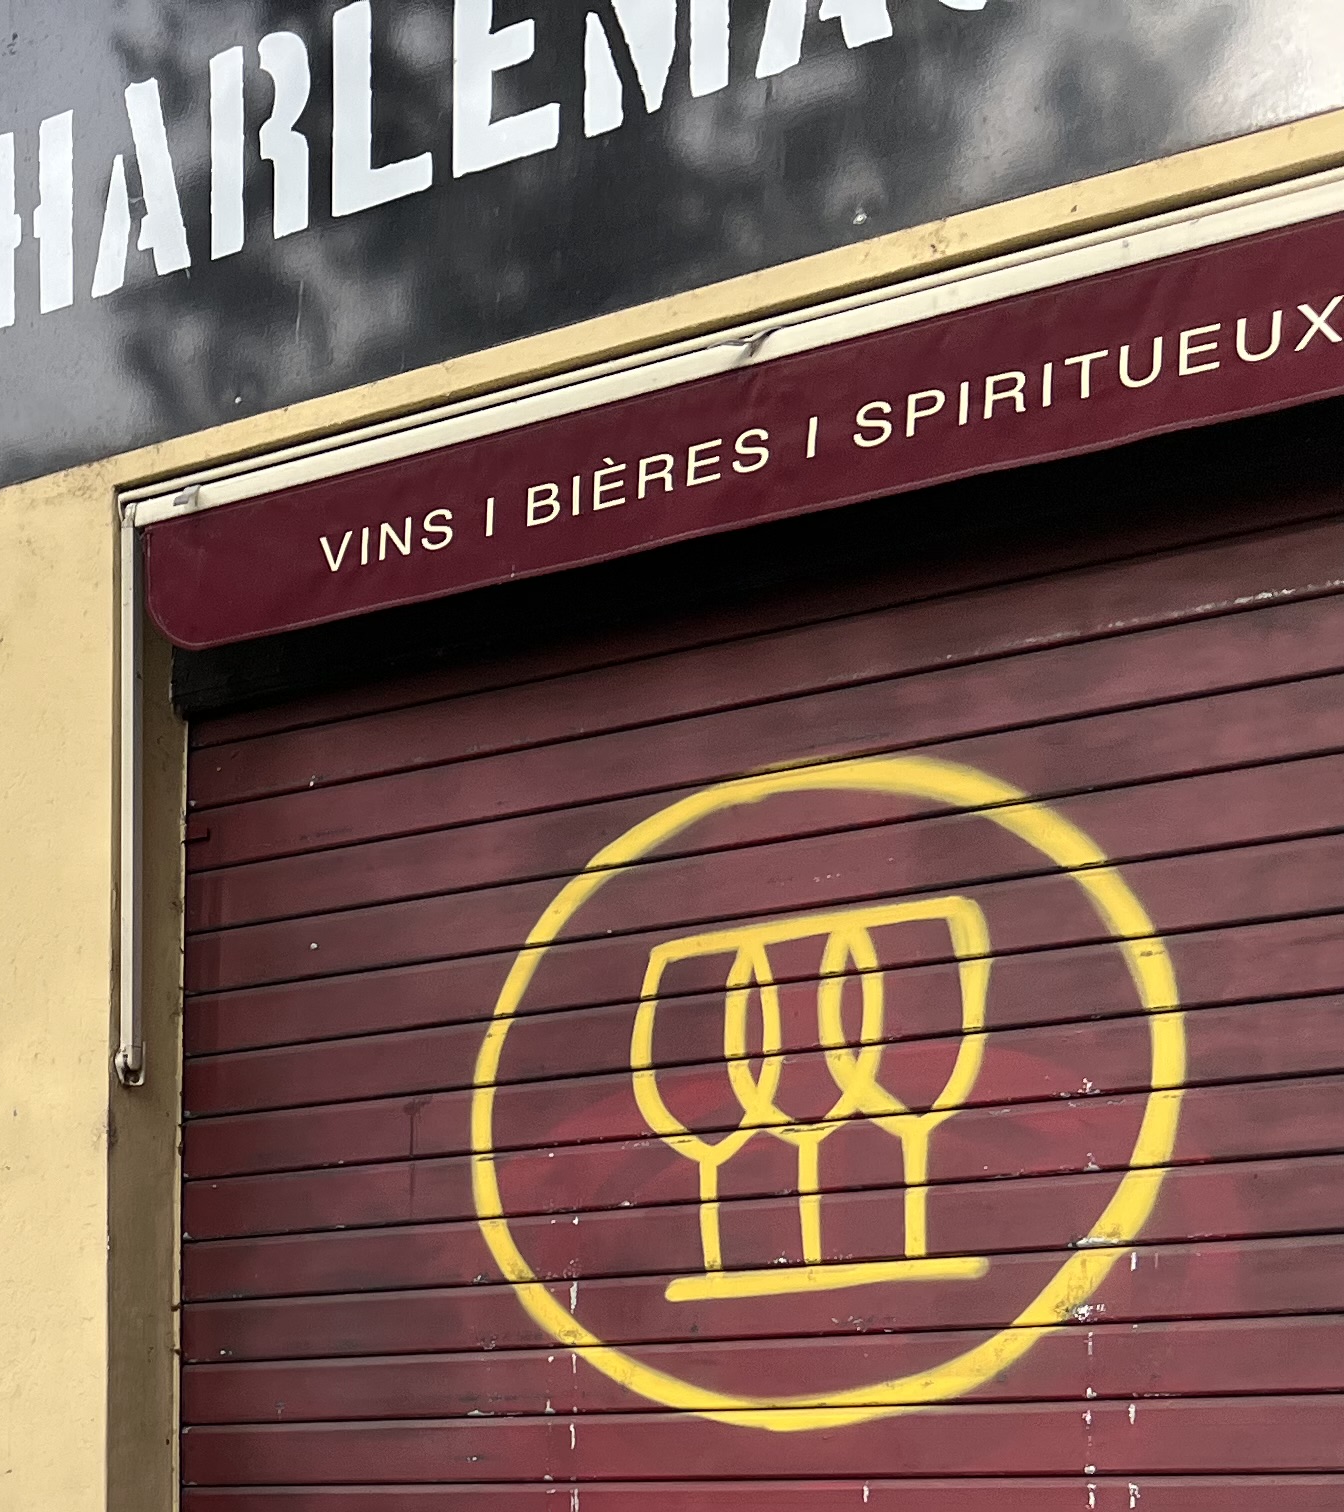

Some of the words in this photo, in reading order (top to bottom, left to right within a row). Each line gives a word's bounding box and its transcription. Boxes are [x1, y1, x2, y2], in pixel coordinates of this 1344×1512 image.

[319, 496, 454, 573] VINS
[526, 428, 770, 528] BIÈRES
[853, 294, 1344, 448] SPIRITUEUX
